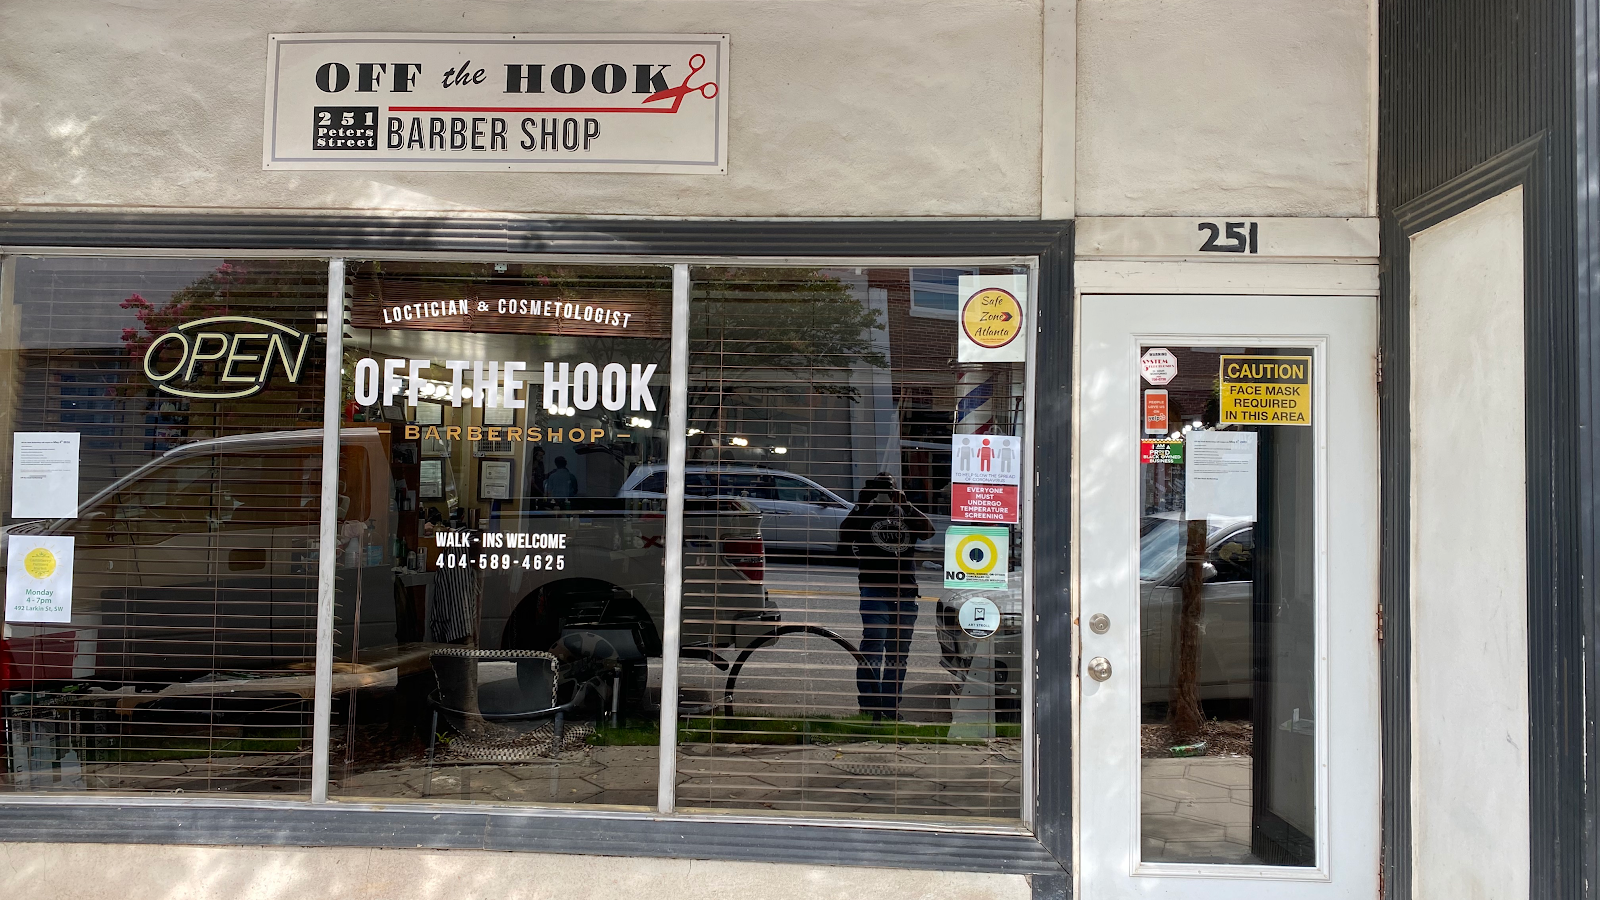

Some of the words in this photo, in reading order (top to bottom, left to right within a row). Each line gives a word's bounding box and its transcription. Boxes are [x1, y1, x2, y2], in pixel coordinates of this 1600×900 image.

[315, 62, 422, 93] OFF
[441, 59, 487, 89] the
[503, 63, 672, 94] HOOK
[317, 127, 374, 137] Peters
[387, 116, 508, 152] BARBER
[520, 117, 601, 152] SHOP
[316, 137, 375, 147] Street
[1198, 221, 1258, 254] 251
[981, 295, 1004, 308] Safe
[383, 299, 468, 324] LOCTICIAN
[477, 301, 489, 312] &
[498, 298, 632, 329] COSMETOLOGIST
[979, 311, 1004, 322] Zone
[974, 326, 1010, 337] Atlanta
[143, 331, 310, 383] OPEN
[1227, 363, 1304, 379] CAUTION
[354, 357, 431, 407] OFF
[445, 360, 527, 409] THE
[542, 361, 658, 412] HOOK
[1230, 385, 1262, 395] FACE
[1265, 386, 1300, 396] MASK
[1234, 398, 1297, 409] REQUIRED
[1225, 410, 1237, 420] IN
[1241, 411, 1268, 421] THIS
[1272, 411, 1305, 422] AREA
[404, 425, 606, 443] BARBERSHOP
[966, 486, 1004, 494] EVERYONE
[960, 505, 1009, 514] TEMPERATURE
[964, 512, 1004, 520] SCREENING
[435, 531, 471, 548] WALK
[482, 532, 504, 548] INS
[506, 533, 567, 549] WELCOME
[435, 553, 565, 571] 404-589-4625
[945, 570, 966, 581] NO
[25, 588, 54, 597] Monday
[36, 597, 52, 605] 7pm
